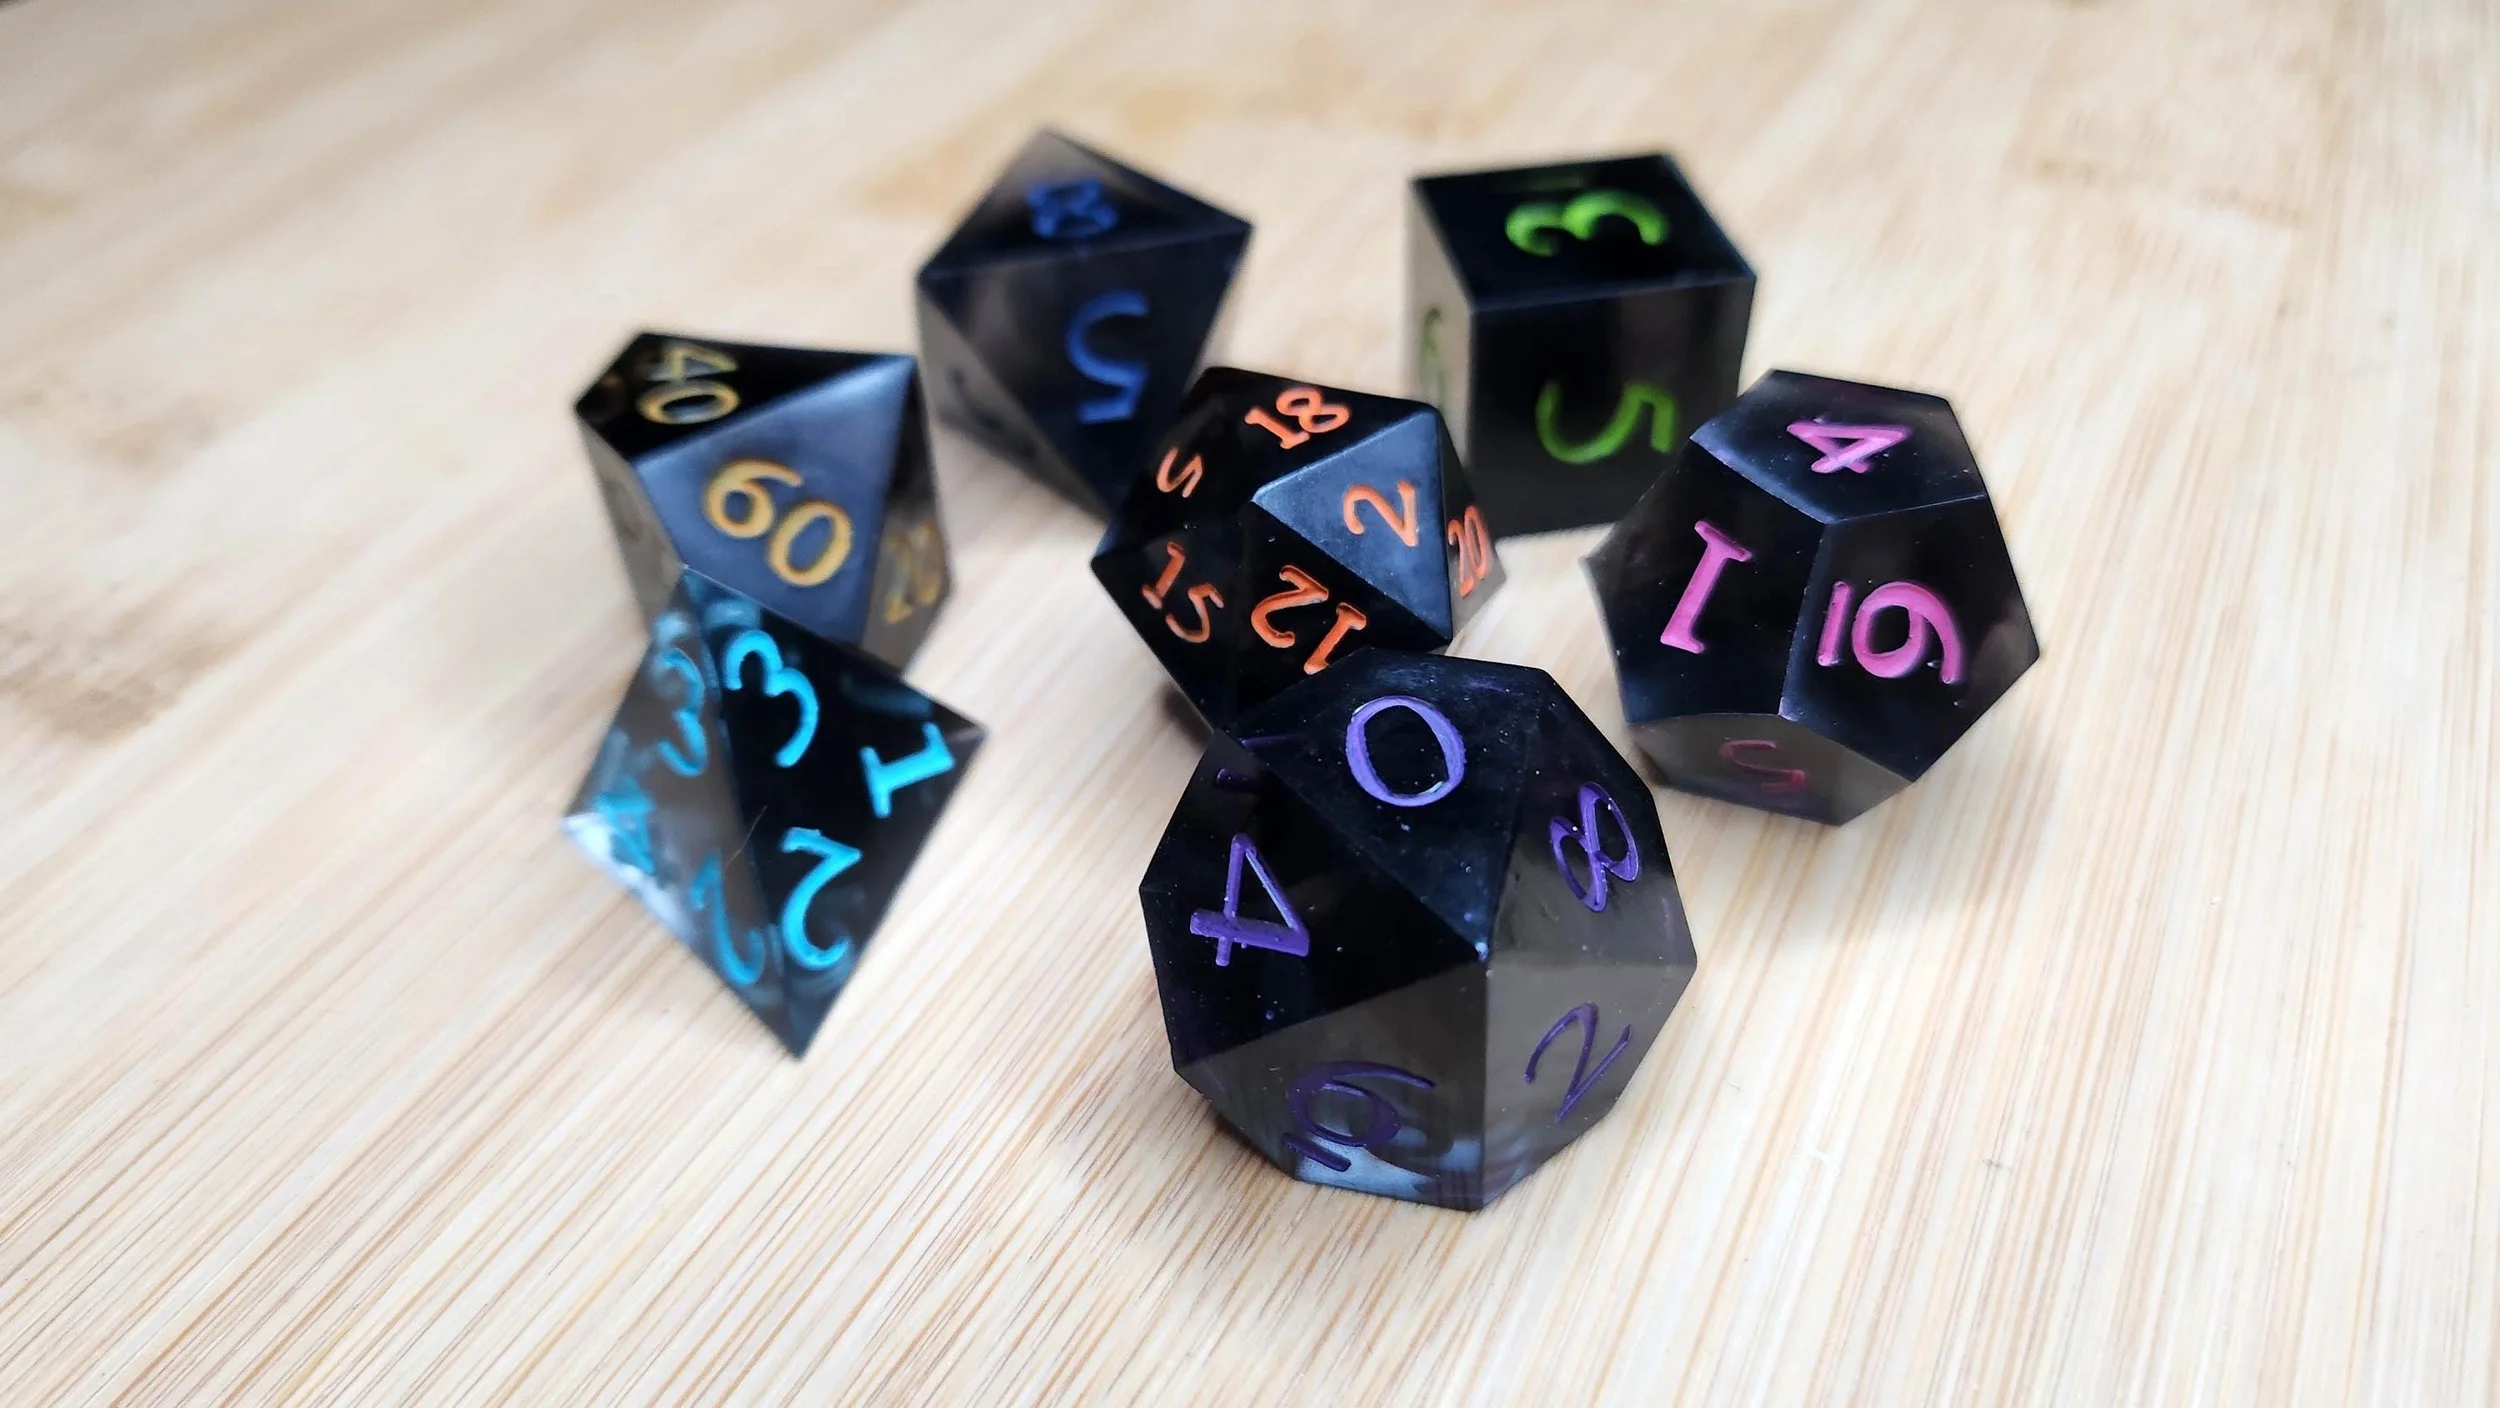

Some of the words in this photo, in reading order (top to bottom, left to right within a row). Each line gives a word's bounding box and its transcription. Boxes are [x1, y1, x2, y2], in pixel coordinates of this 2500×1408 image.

[1504, 189, 1670, 258] 3
[636, 345, 741, 425] 40
[1066, 289, 1151, 425] 5
[1244, 384, 1352, 450] 18
[1535, 381, 1677, 465] 5
[1787, 420, 1909, 474] 4
[703, 458, 855, 589] 60
[1156, 448, 1203, 499] 5
[1343, 480, 1419, 547] 2
[1142, 542, 1224, 644] 15
[1448, 505, 1489, 598] 20
[1660, 520, 1753, 655] 1
[1251, 565, 1367, 675] 12
[723, 629, 819, 768] 3
[1345, 695, 1466, 807] 0
[861, 721, 956, 818] 1
[780, 827, 862, 970] 2
[1190, 833, 1310, 966] 4
[1549, 782, 1639, 912] 8
[1524, 1002, 1633, 1123] 2
